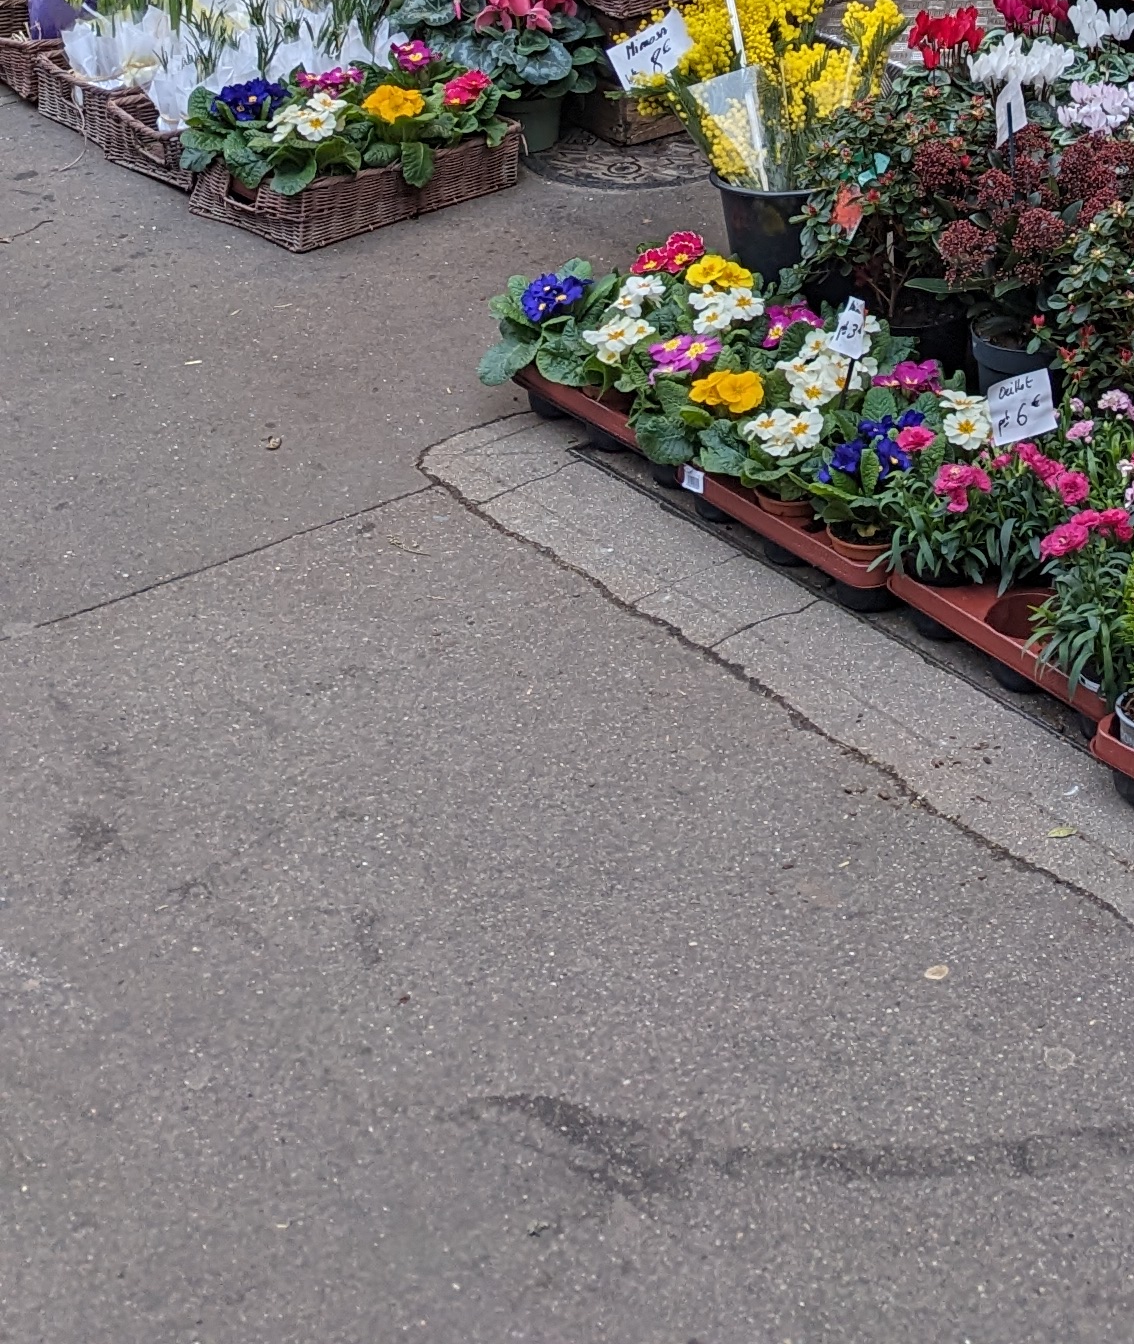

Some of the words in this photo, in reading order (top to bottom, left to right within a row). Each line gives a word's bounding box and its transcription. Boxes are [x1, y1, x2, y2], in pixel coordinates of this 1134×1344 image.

[625, 26, 668, 61] Mimosa
[650, 38, 672, 74] 8€
[1016, 394, 1041, 426] 6€
